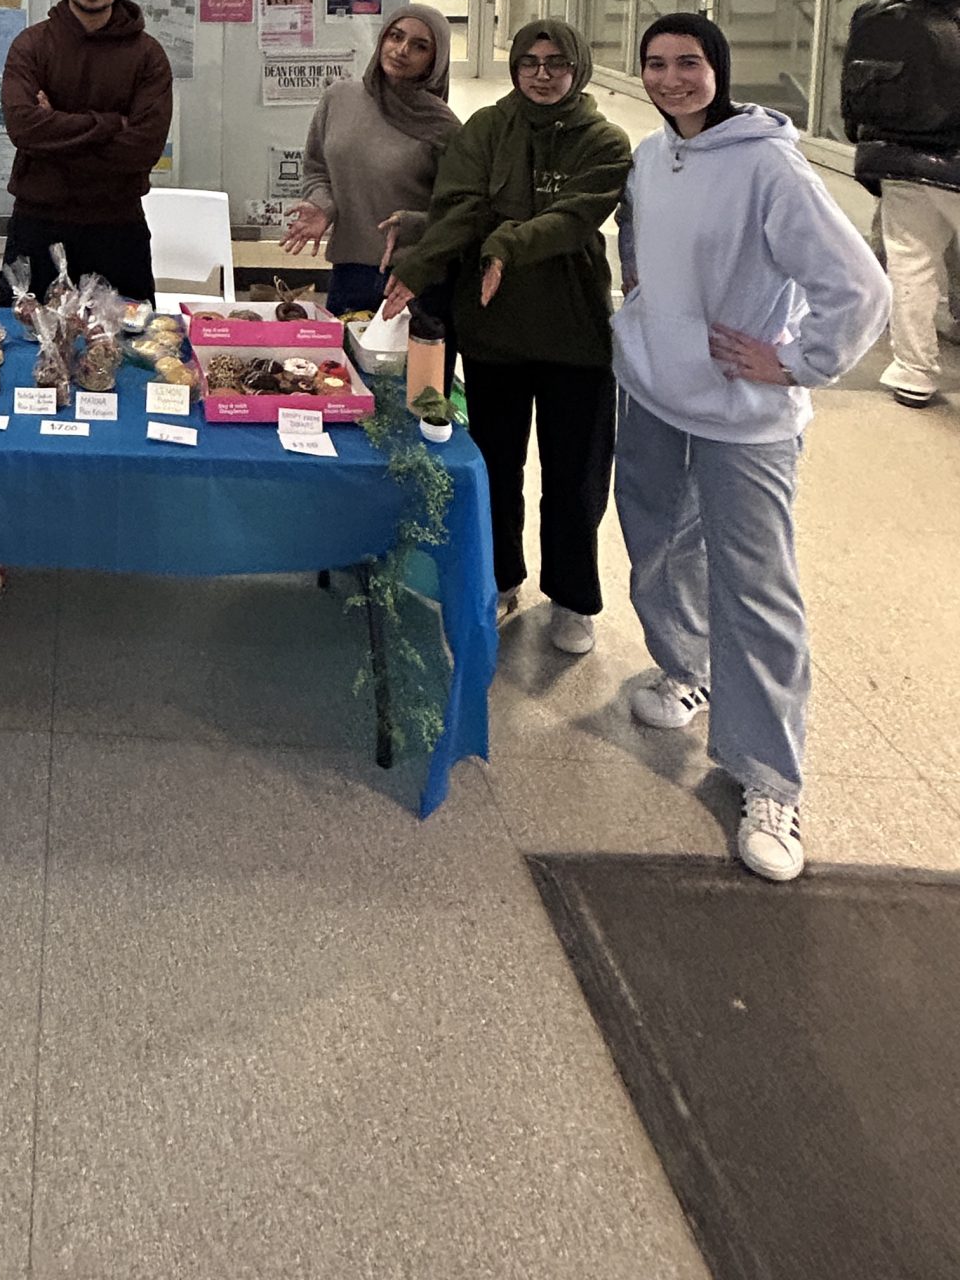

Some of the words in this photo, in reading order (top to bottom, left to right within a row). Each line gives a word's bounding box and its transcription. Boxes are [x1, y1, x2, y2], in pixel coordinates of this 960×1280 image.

[264, 65, 287, 77] DEAN
[288, 65, 306, 77] FOR
[308, 65, 324, 77] THE
[326, 65, 343, 76] DAY
[277, 77, 320, 88] CONTEST!
